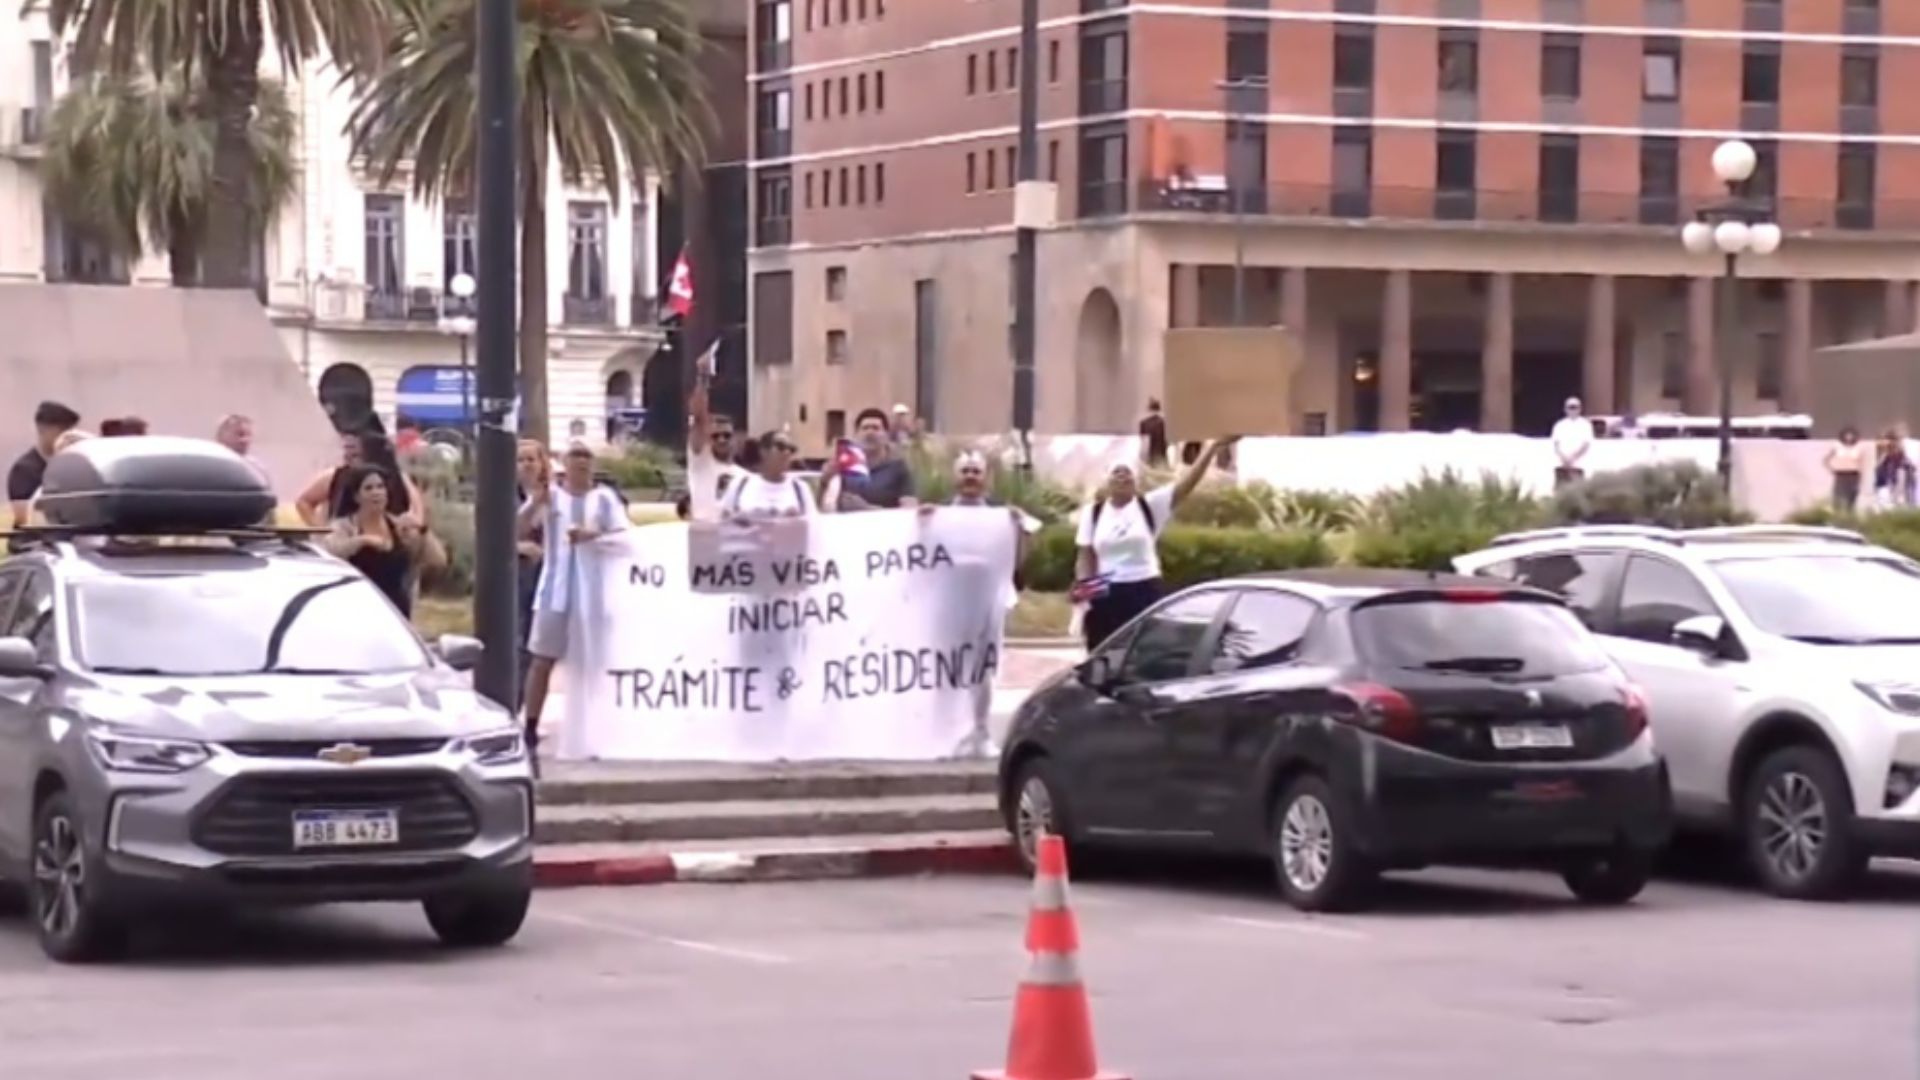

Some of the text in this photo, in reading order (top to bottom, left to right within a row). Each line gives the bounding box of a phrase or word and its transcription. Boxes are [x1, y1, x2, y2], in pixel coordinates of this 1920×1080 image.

[629, 563, 665, 588] NO
[865, 543, 954, 578] PARA
[345, 819, 394, 841] 4473
